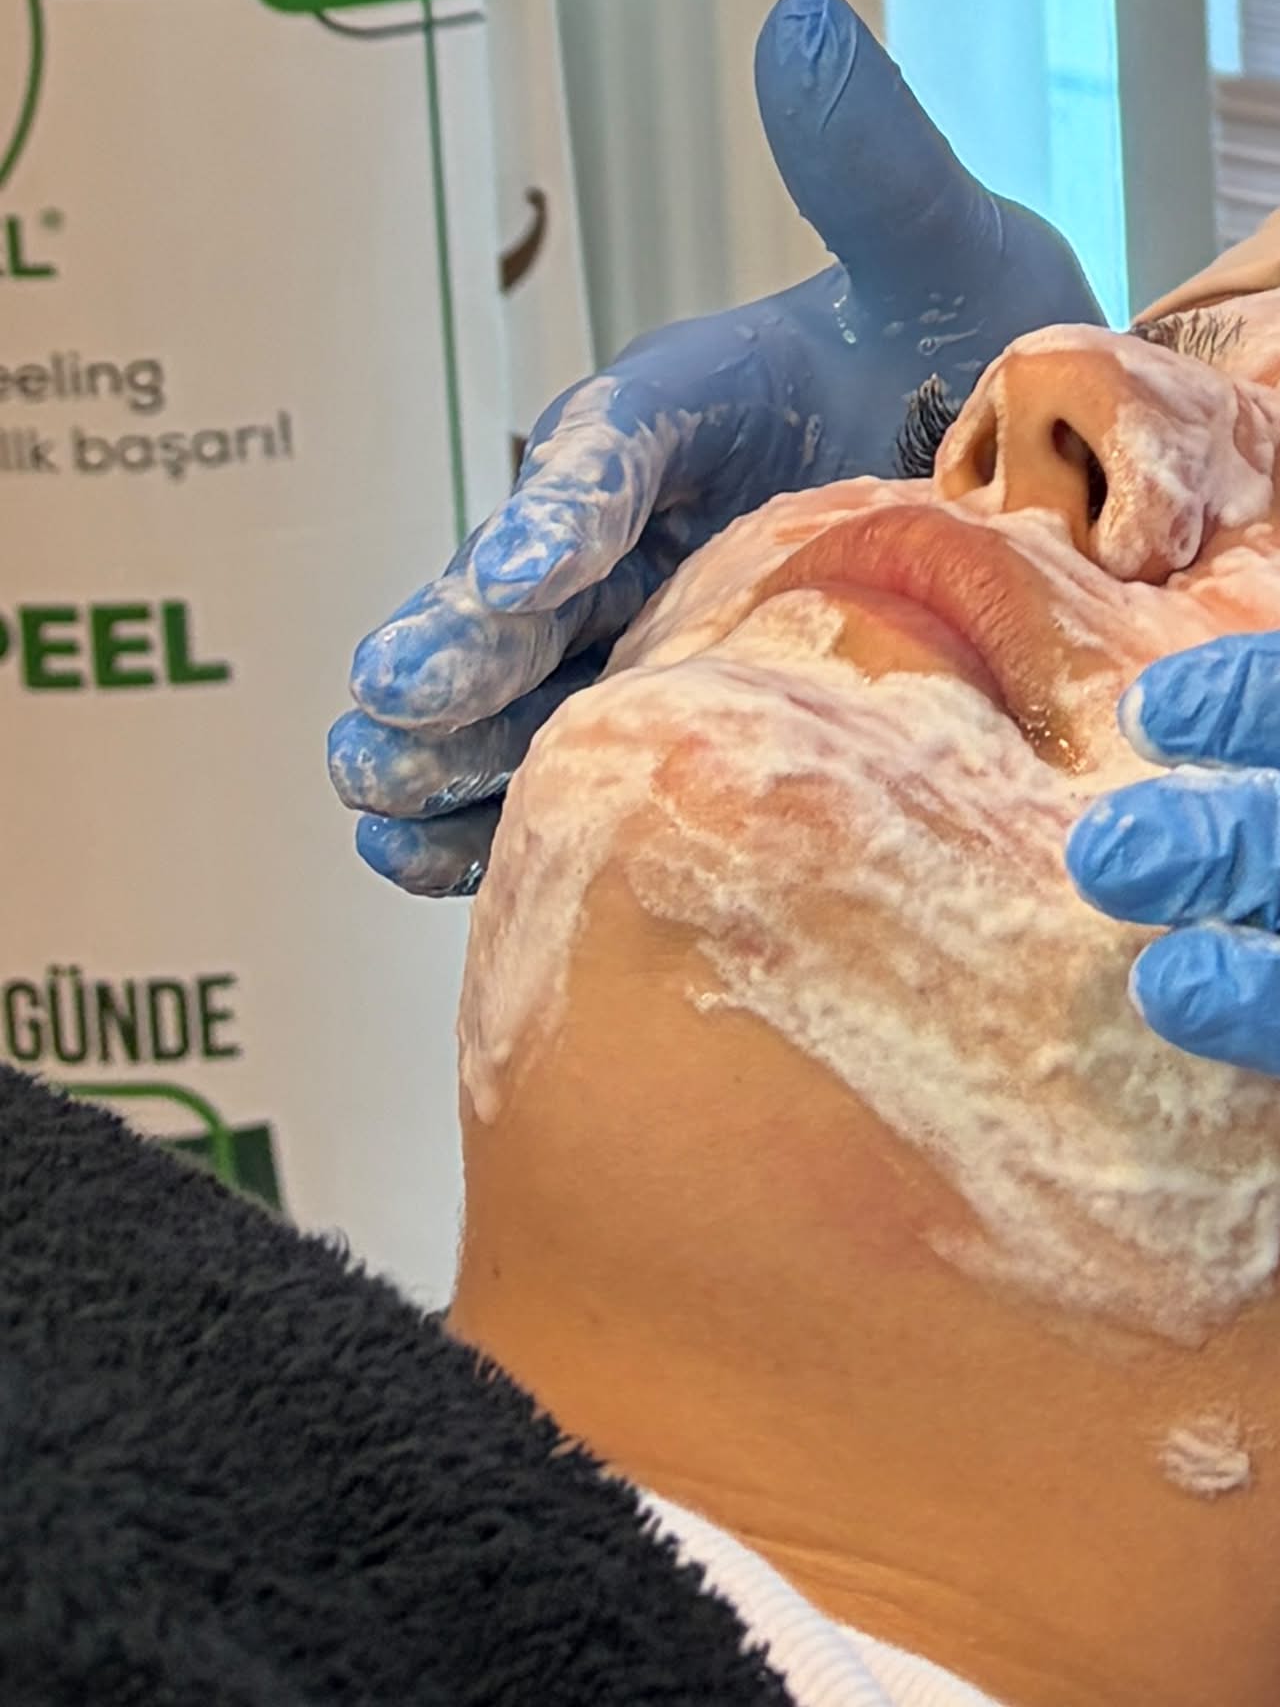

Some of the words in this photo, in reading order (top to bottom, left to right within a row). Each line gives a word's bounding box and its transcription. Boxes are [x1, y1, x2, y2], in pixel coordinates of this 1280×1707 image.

[0, 350, 165, 417] eling
[0, 599, 231, 691] EEL
[4, 964, 241, 1064] GÜNDE
